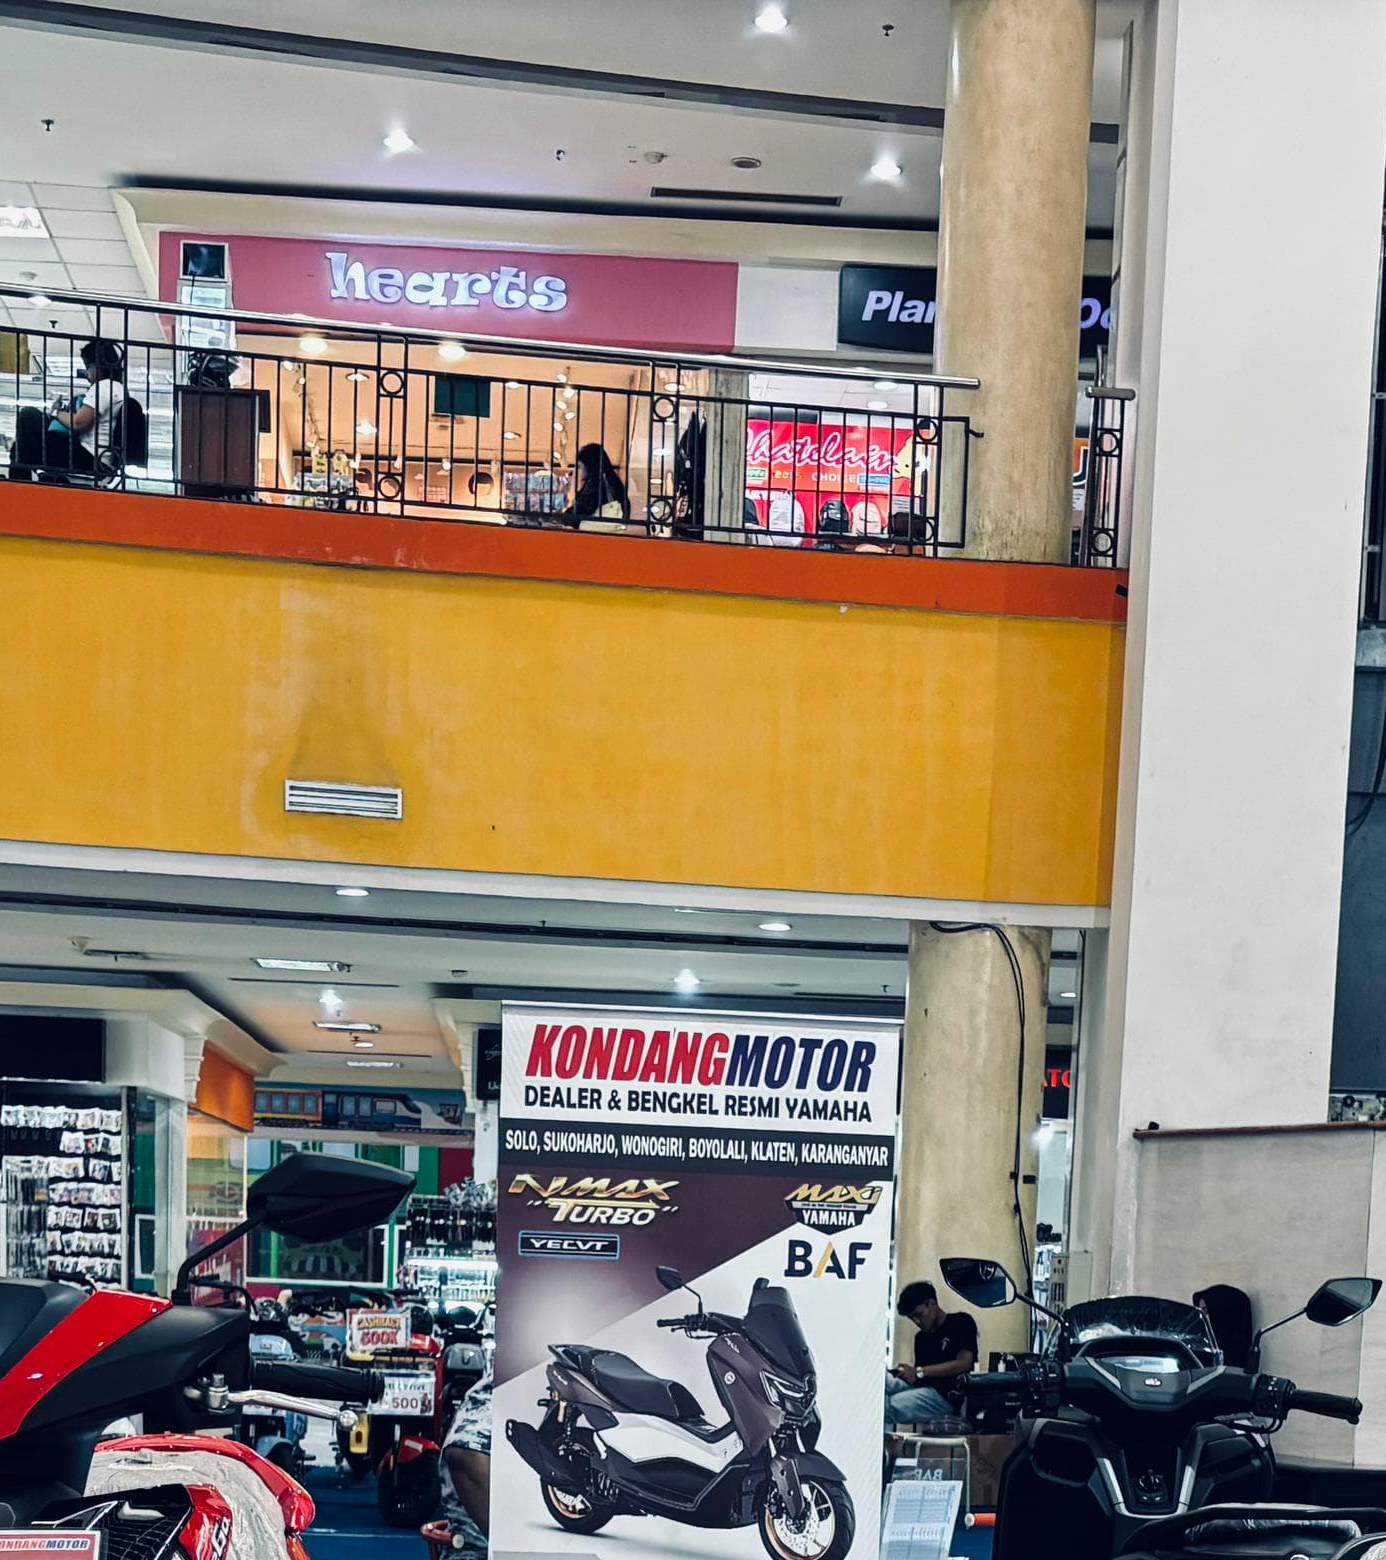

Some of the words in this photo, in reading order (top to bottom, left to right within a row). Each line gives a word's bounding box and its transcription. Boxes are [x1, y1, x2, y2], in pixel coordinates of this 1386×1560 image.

[325, 251, 568, 312] hearts
[526, 1024, 877, 1093] KONDANGMOTOR
[524, 1085, 602, 1110] DEALER
[608, 1091, 622, 1111] &
[628, 1091, 719, 1116] BENGKEL
[724, 1095, 780, 1119] RESMI
[785, 1098, 873, 1123] YAMAHA
[505, 1131, 541, 1154] SOLO,
[543, 1132, 618, 1158] SUKOHARJO,
[621, 1135, 686, 1161] WONOGIRI,
[689, 1138, 748, 1163] BOYOLALI,
[751, 1141, 798, 1166] KLATEN,
[801, 1144, 889, 1167] KARANGANYAR
[508, 1174, 680, 1200] NMAX
[802, 1209, 856, 1226] YAMAHA
[530, 1238, 610, 1251] YECVT
[784, 1239, 873, 1280] BAF
